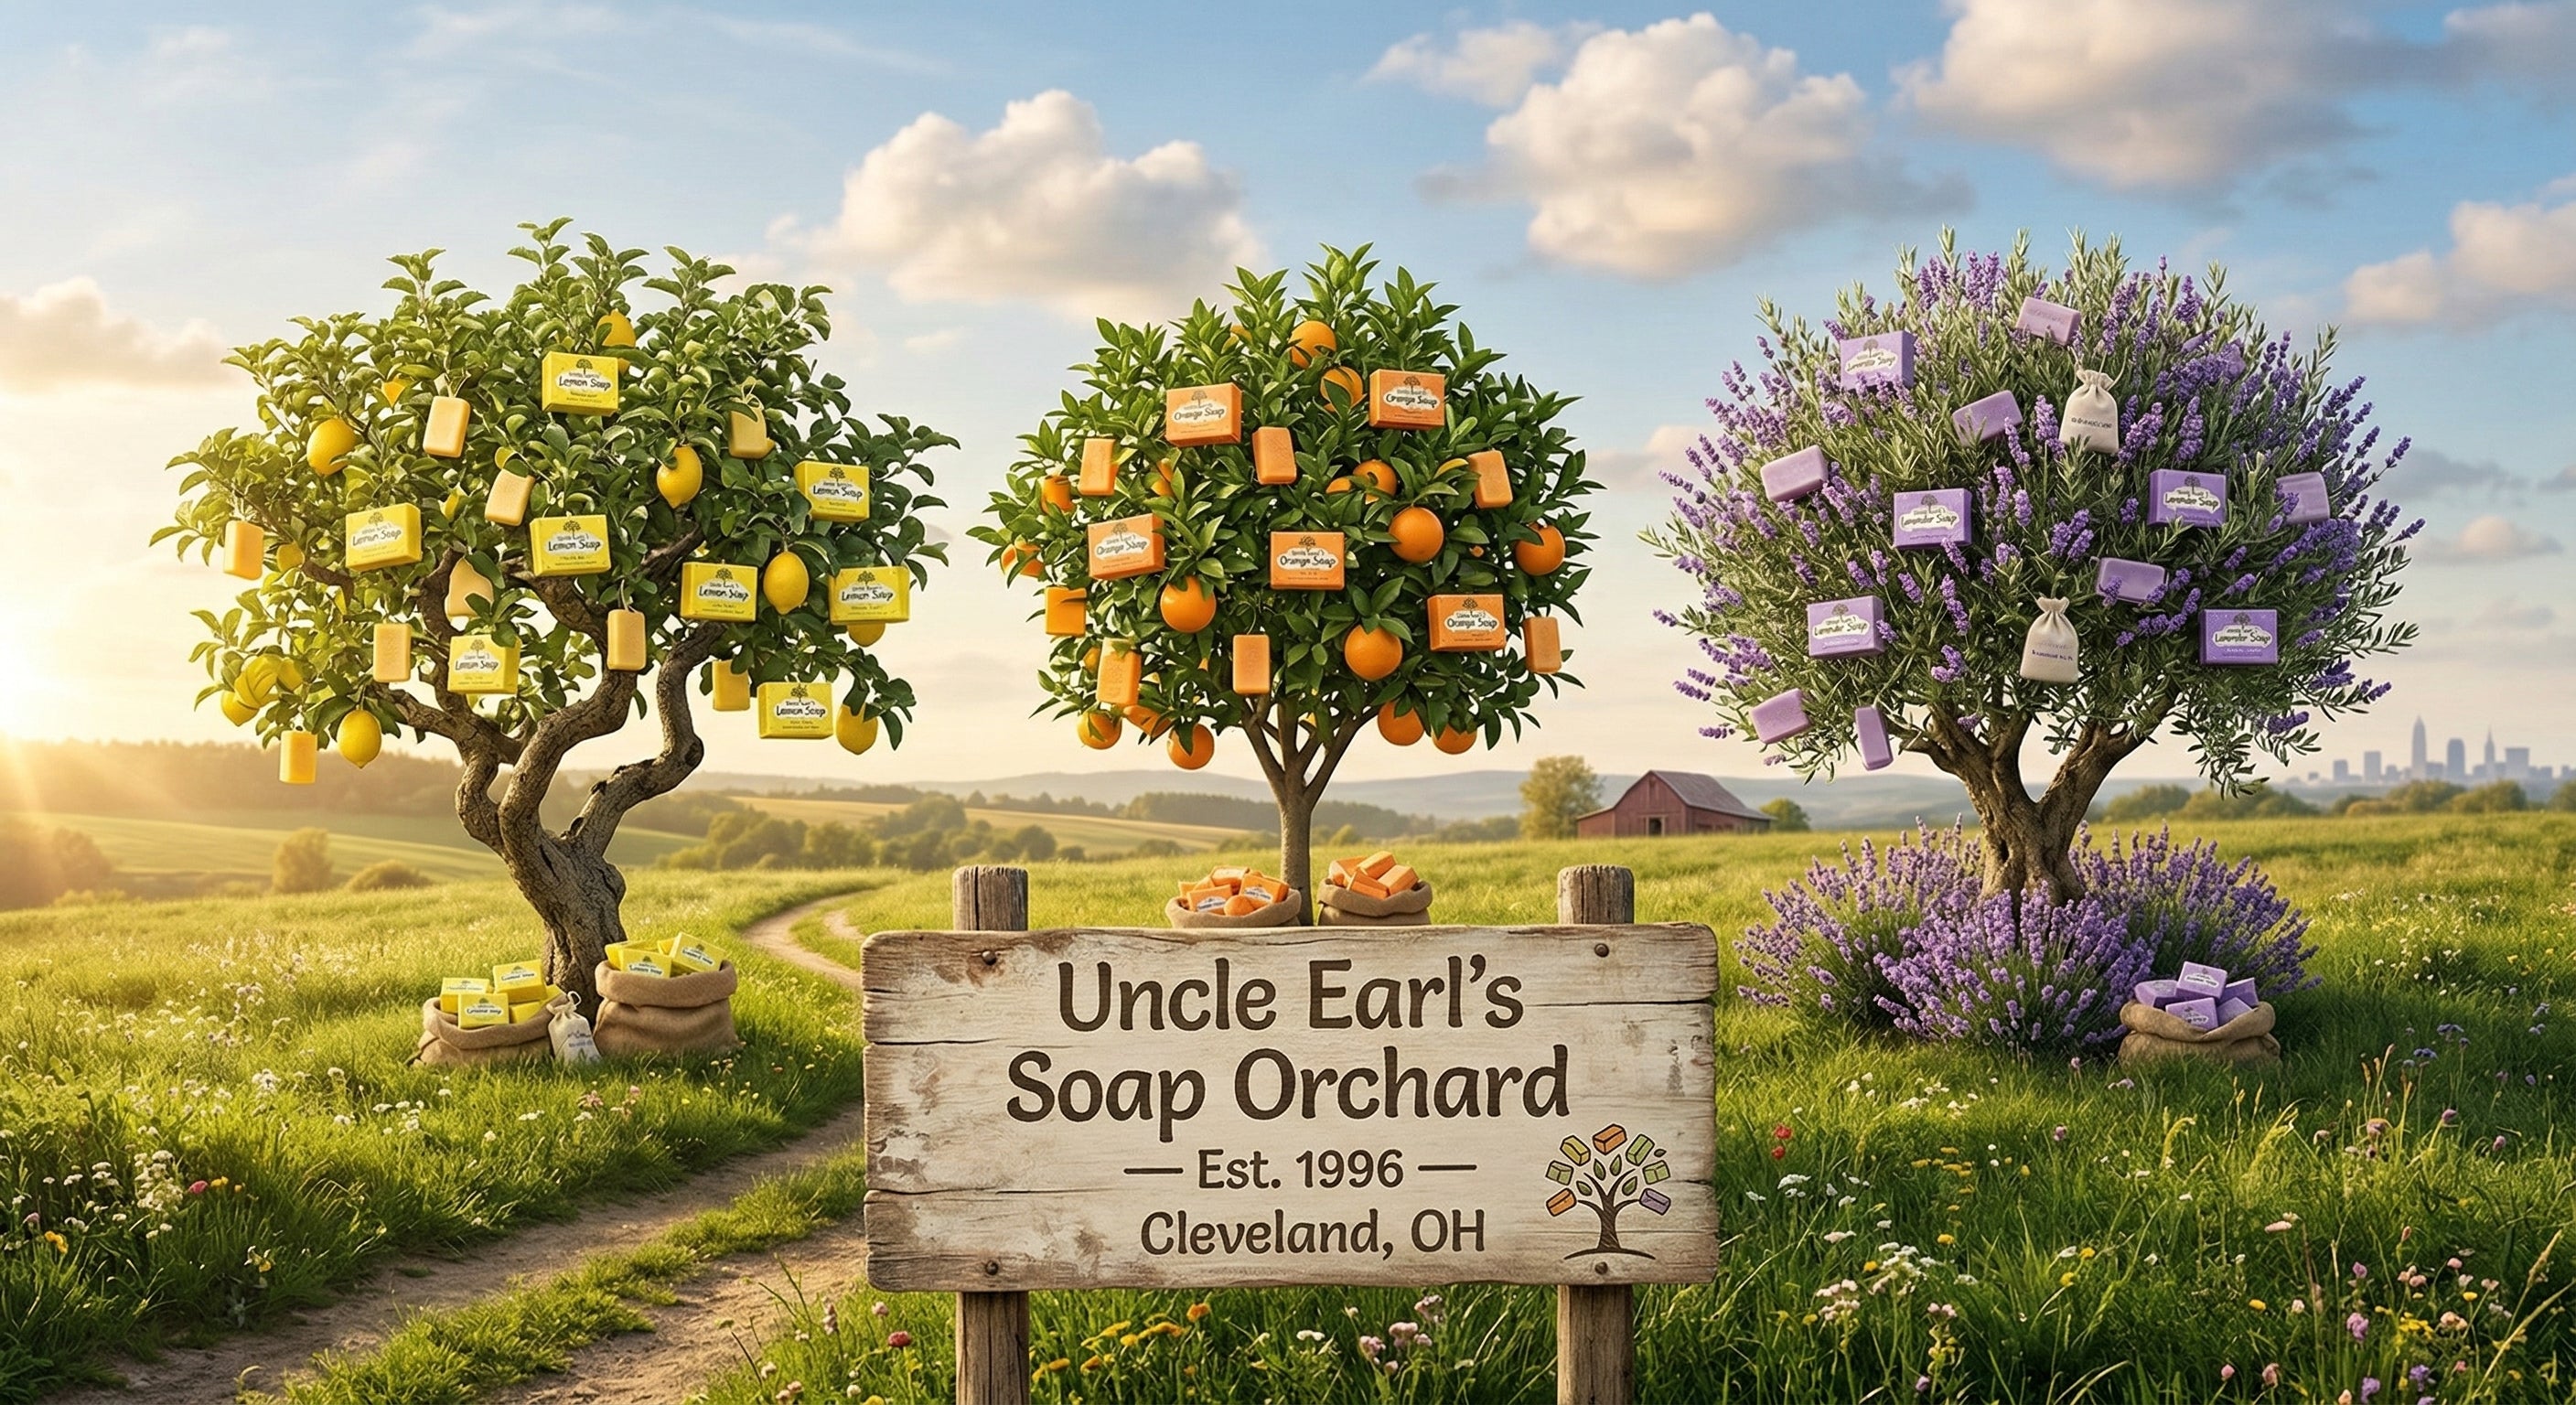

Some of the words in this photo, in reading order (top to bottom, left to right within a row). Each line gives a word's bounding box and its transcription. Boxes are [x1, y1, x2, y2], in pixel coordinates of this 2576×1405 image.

[559, 376, 588, 388] Lemon
[590, 378, 611, 391] Soap
[381, 530, 402, 541] Soap
[548, 541, 576, 552] Lemon
[1280, 555, 1311, 568] Orange
[1312, 555, 1336, 568] Soap
[1057, 958, 1277, 1033] Uncle
[1308, 953, 1524, 1030] Earl's
[1006, 1050, 1206, 1143] Soap
[1234, 1044, 1570, 1121] Orchard
[1197, 1148, 1282, 1190] Est.
[1295, 1149, 1404, 1189] 1996
[1141, 1208, 1394, 1261] Cleveland,
[1411, 1208, 1486, 1253] OH
